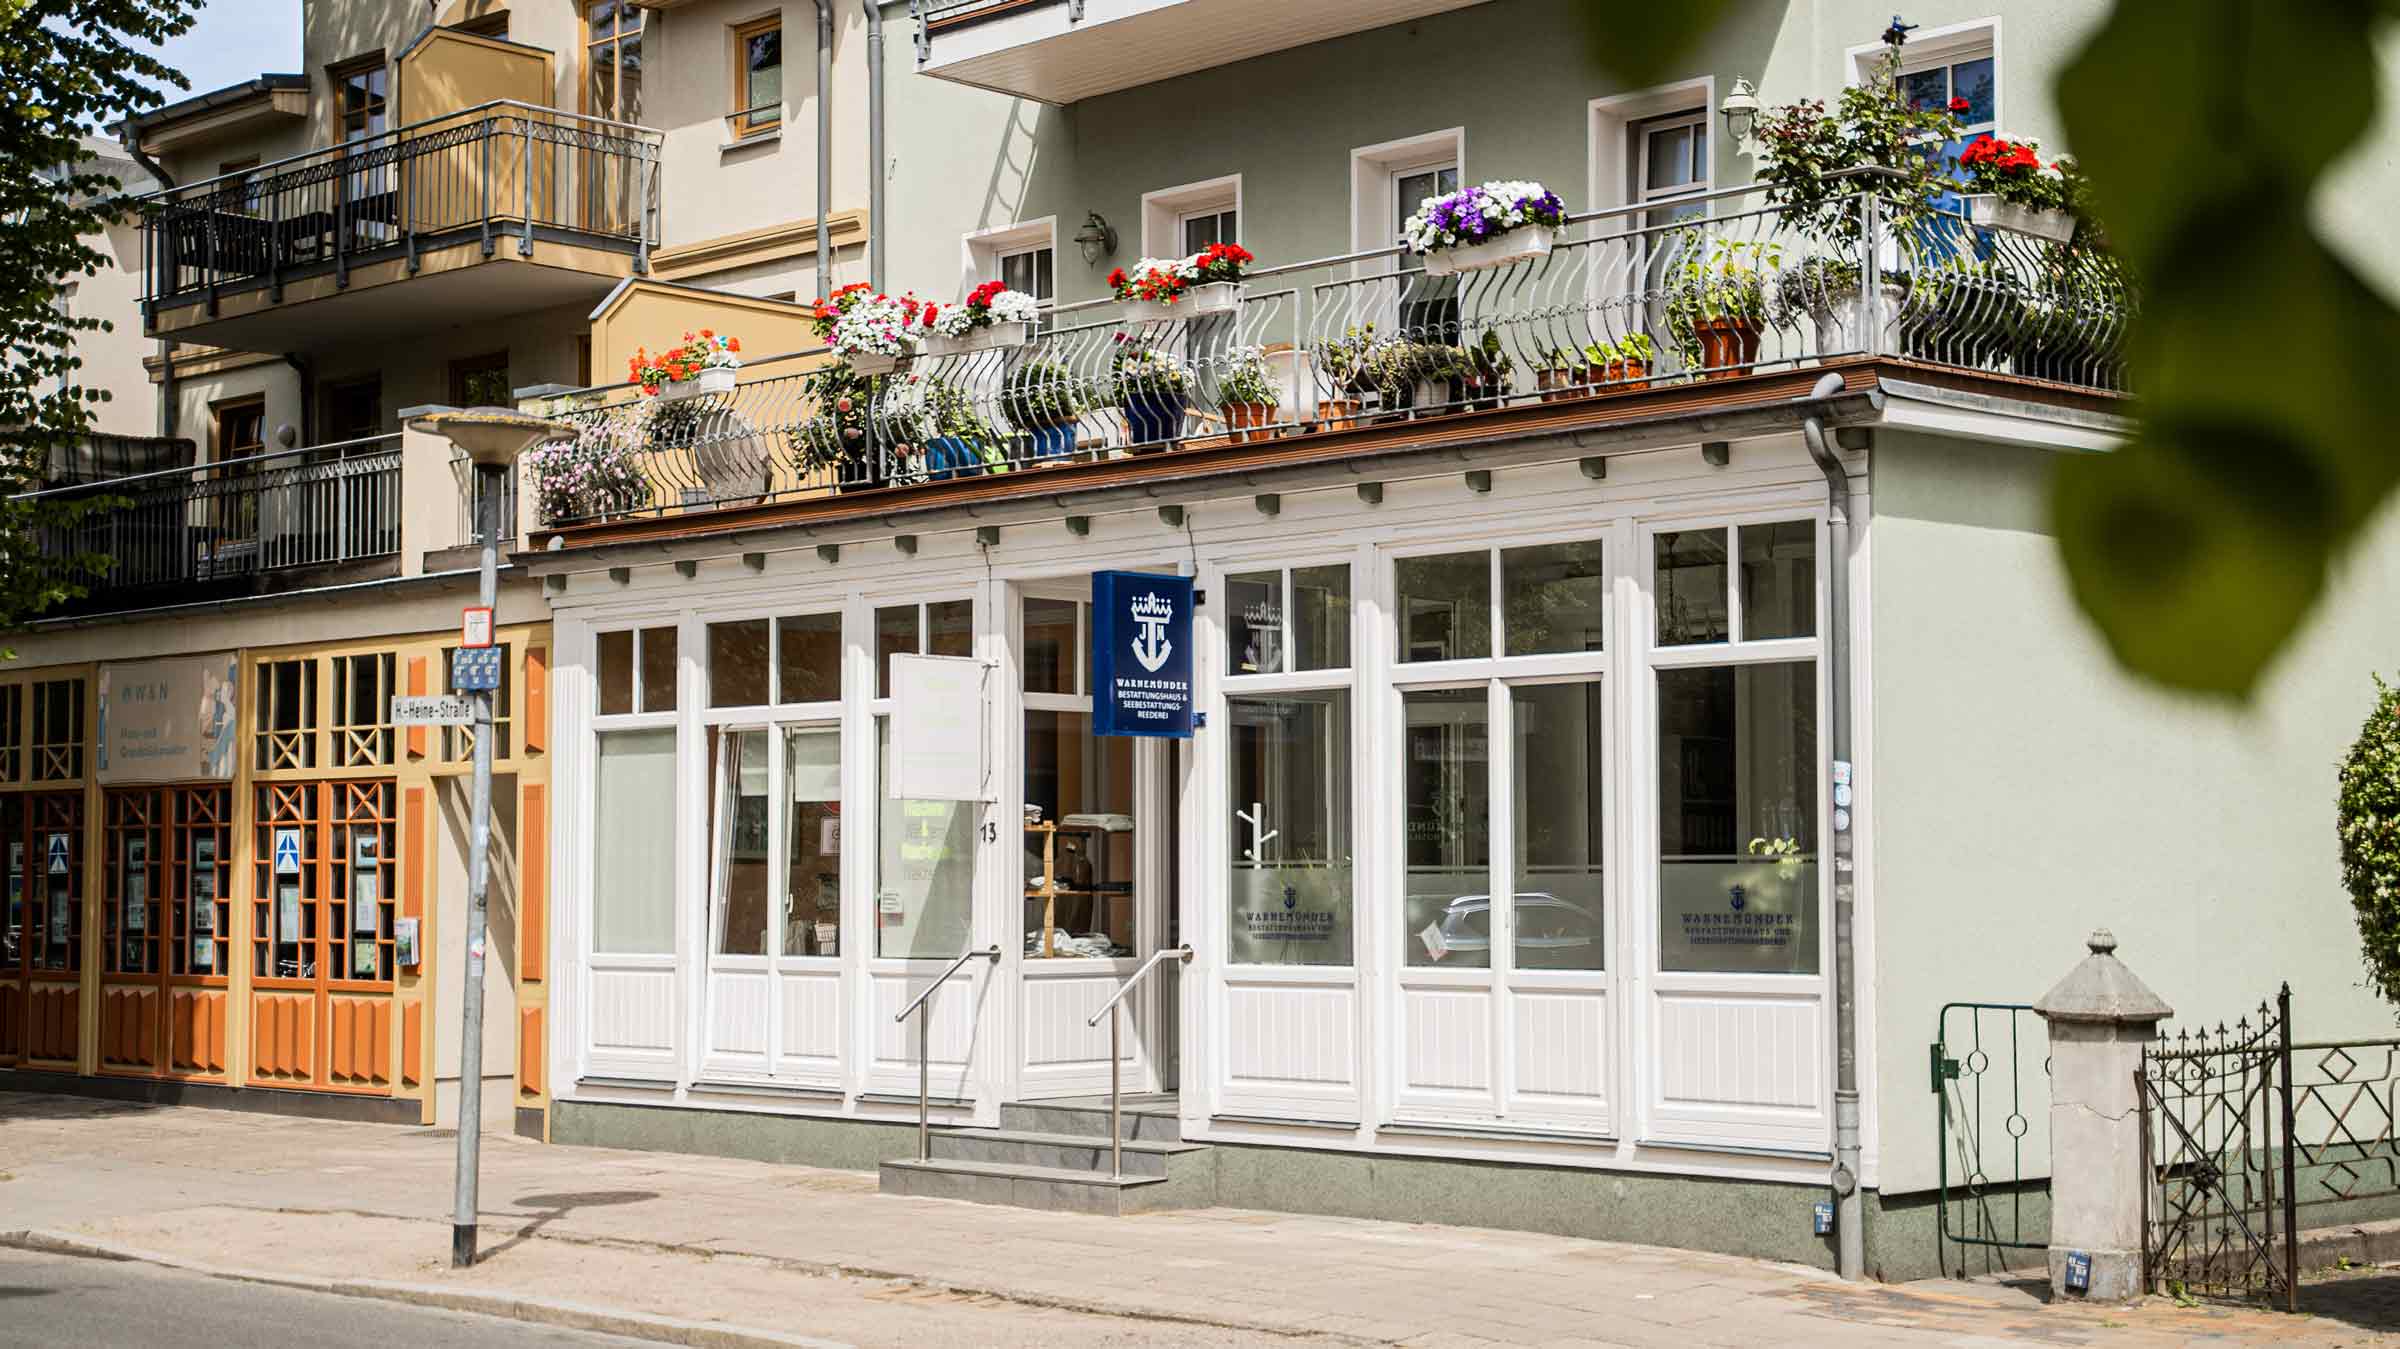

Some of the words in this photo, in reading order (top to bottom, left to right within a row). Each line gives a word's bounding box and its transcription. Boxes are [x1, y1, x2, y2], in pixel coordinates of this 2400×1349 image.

[1115, 678, 1189, 690] WARNEMÜNDER
[1117, 690, 1181, 701] BESTATTUNGSHAUS
[1182, 693, 1188, 701] &
[395, 699, 470, 720] H.-Heine-Straße
[1123, 700, 1183, 711] SEEBESTATTUNGS-
[1137, 710, 1169, 720] REEDEREI
[980, 822, 997, 843] 13
